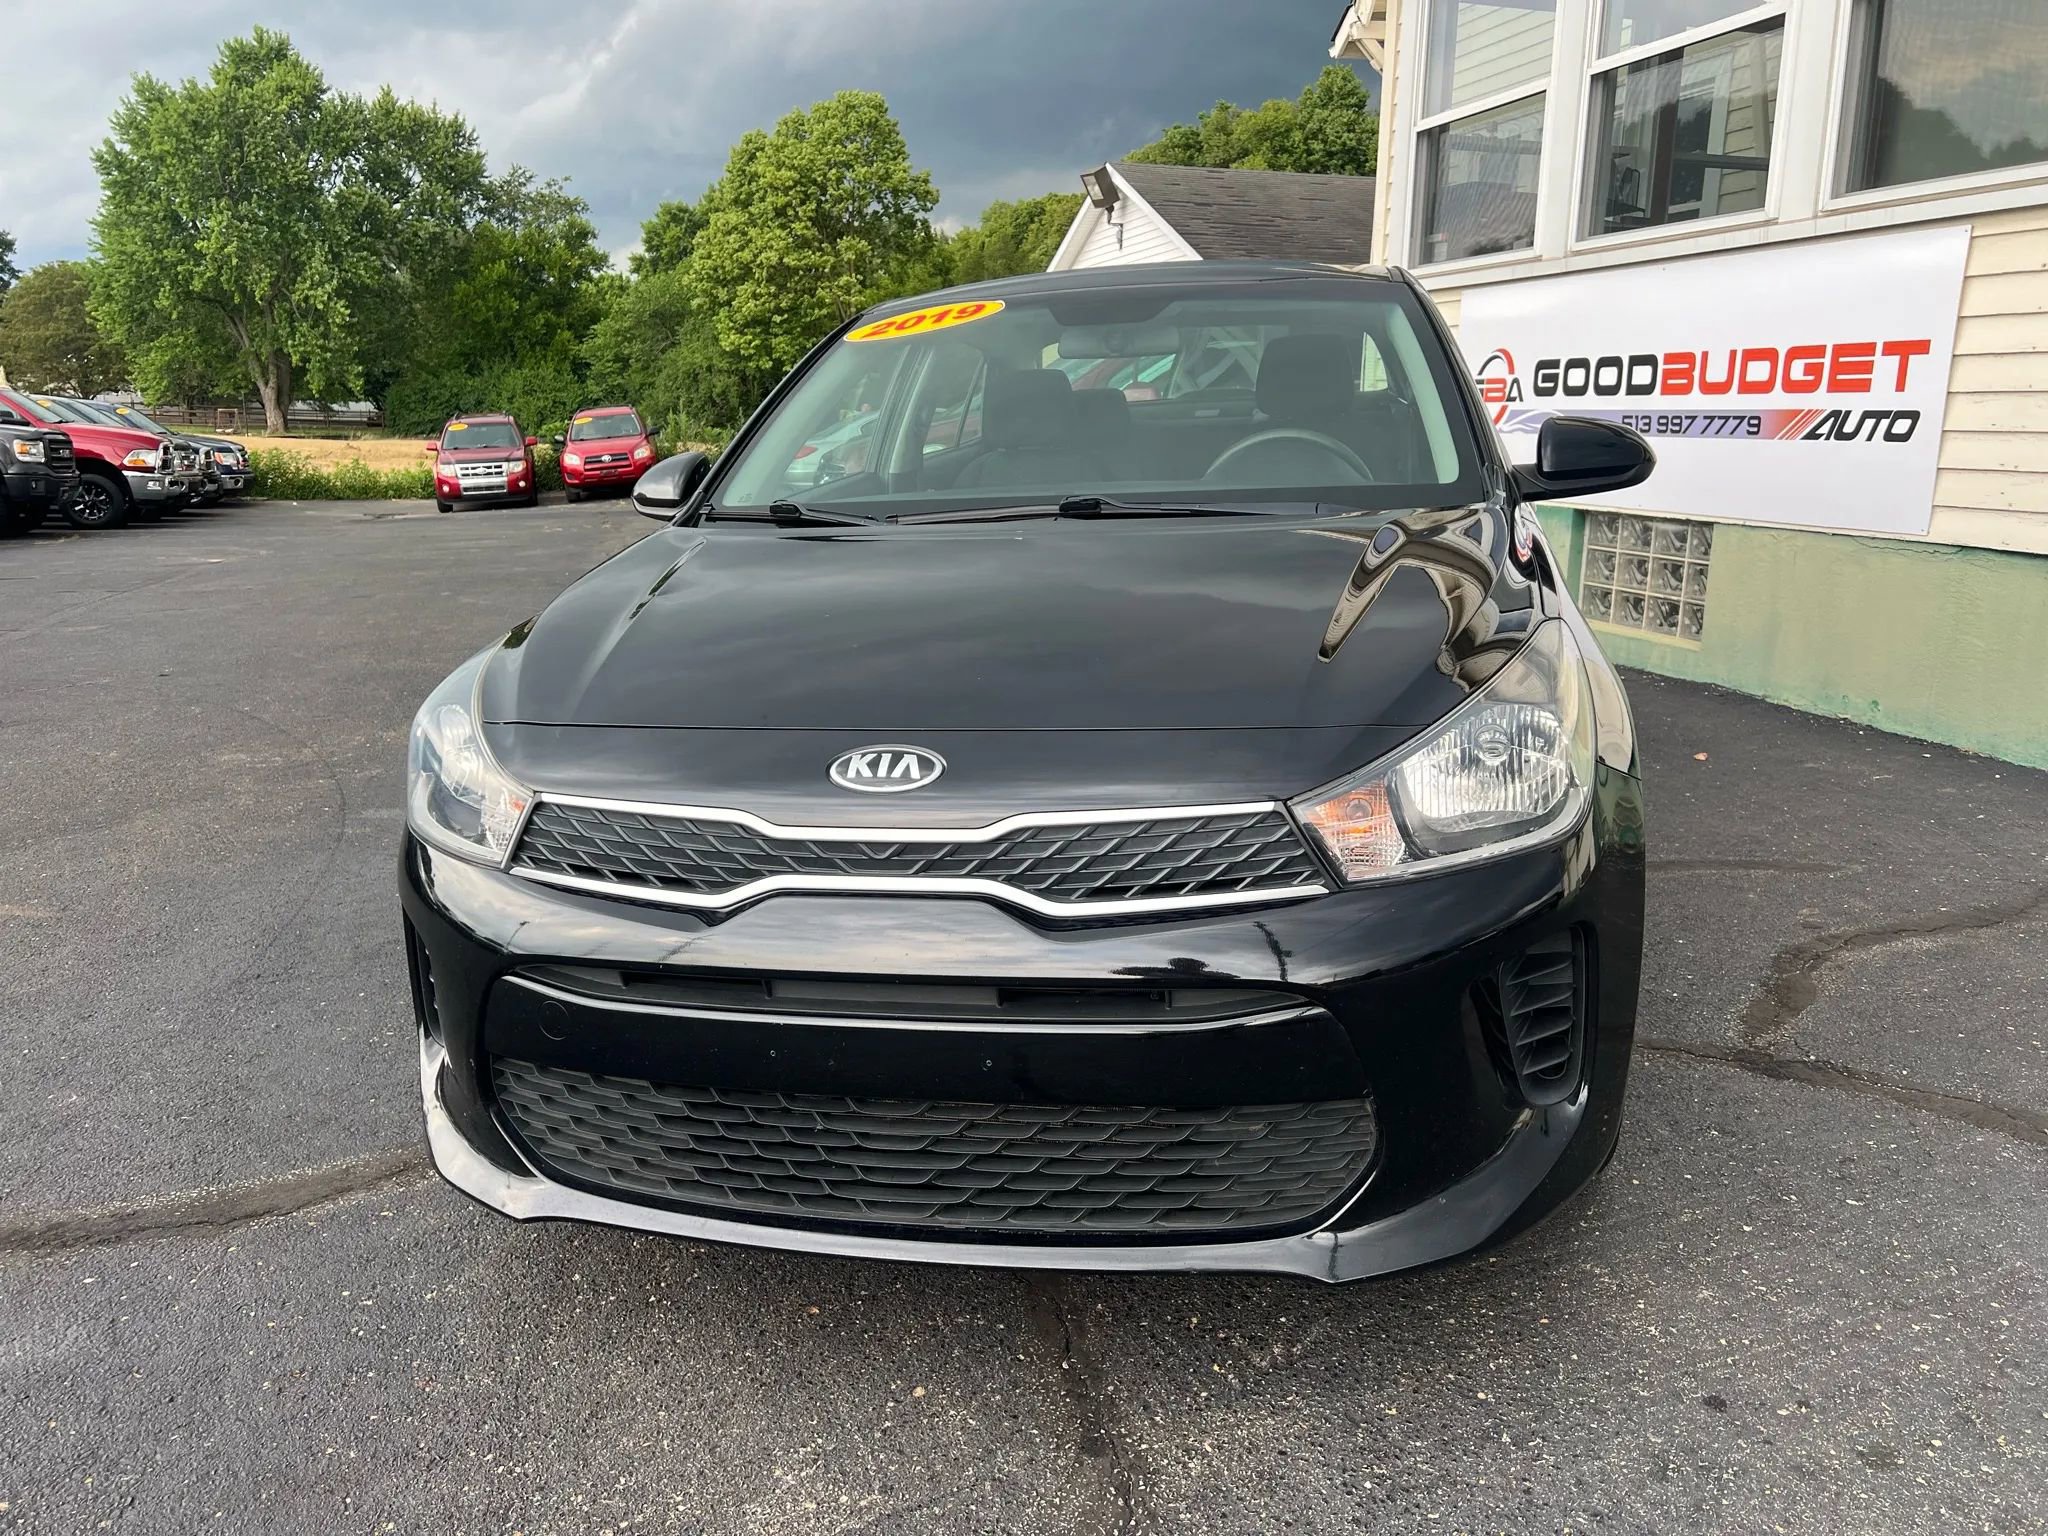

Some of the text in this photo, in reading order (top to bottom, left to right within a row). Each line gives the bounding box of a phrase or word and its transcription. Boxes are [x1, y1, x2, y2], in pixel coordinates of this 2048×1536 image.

[861, 303, 986, 339] 2019
[1622, 415, 1762, 435] 513 997 7779
[1803, 409, 1922, 443] AUTO
[846, 753, 921, 779] KIA
